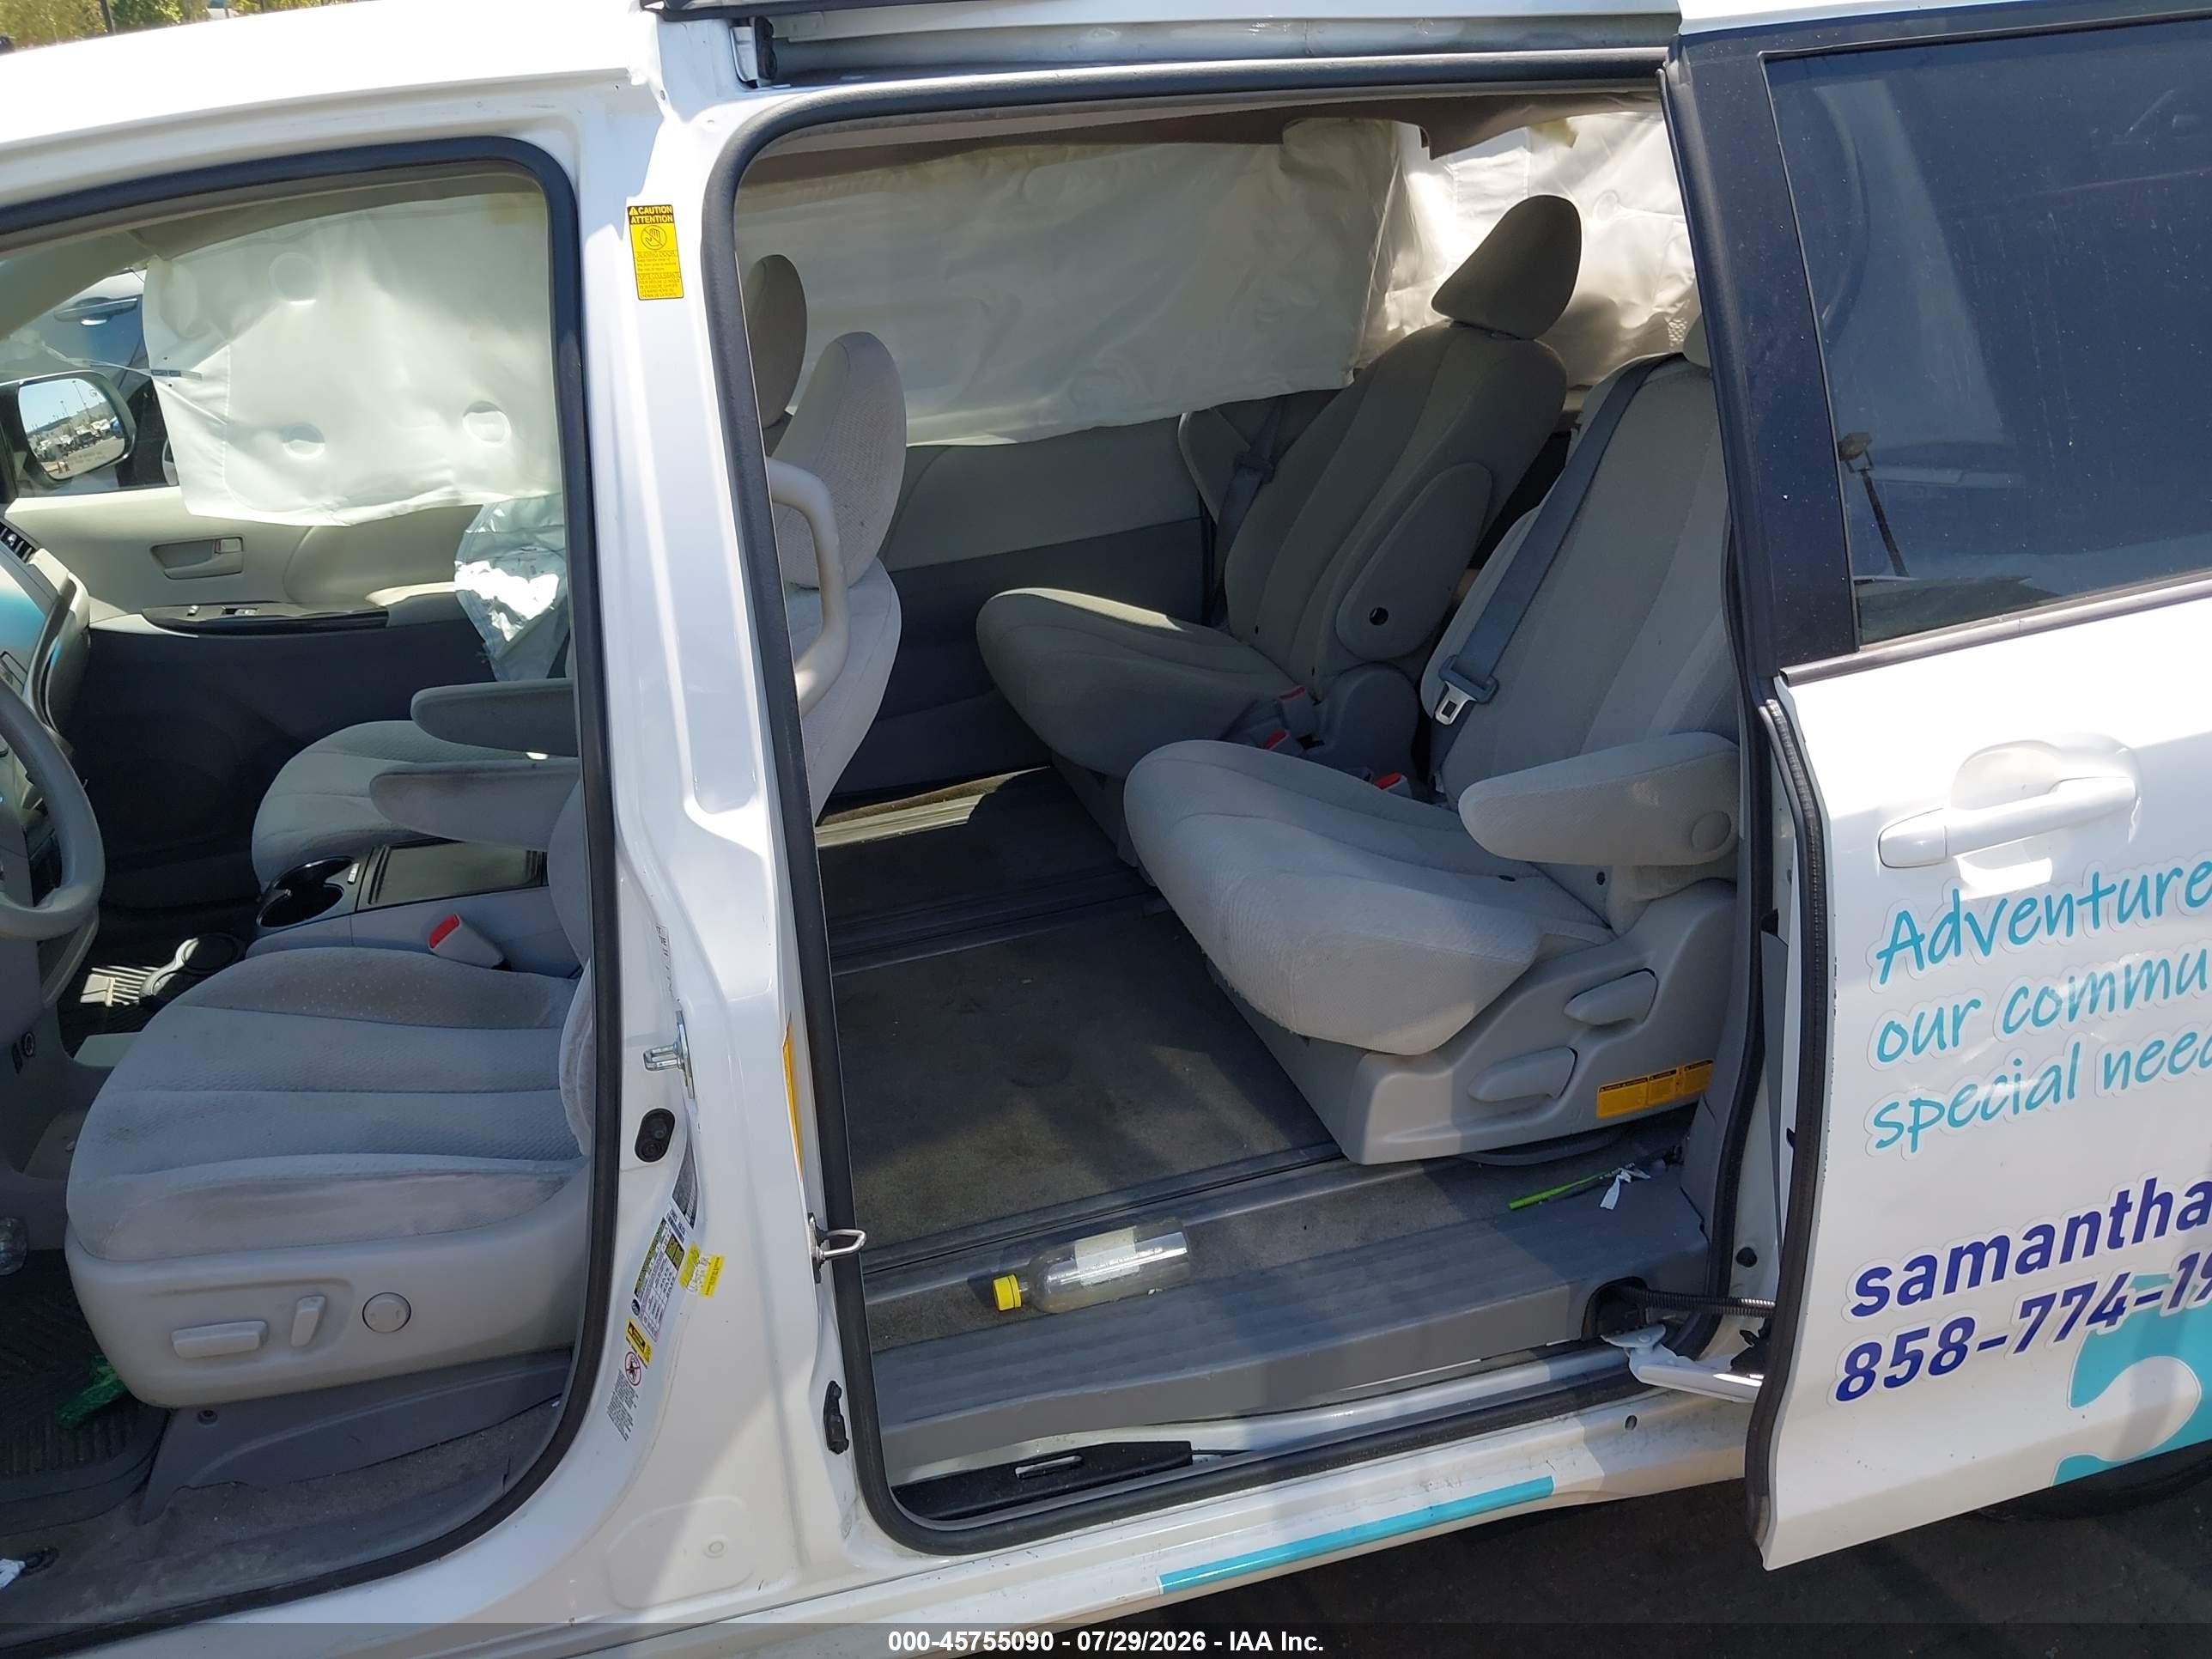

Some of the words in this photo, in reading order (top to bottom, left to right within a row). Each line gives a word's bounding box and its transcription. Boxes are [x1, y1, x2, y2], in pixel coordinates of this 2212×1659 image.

[630, 215, 673, 224] ATTENTION
[638, 206, 672, 215] CAUTION
[1875, 861, 2212, 985] Adventure
[1876, 998, 1981, 1064] our
[2002, 948, 2208, 1036] commu
[1873, 1042, 2081, 1153] special
[1850, 1177, 2212, 1318] samantha
